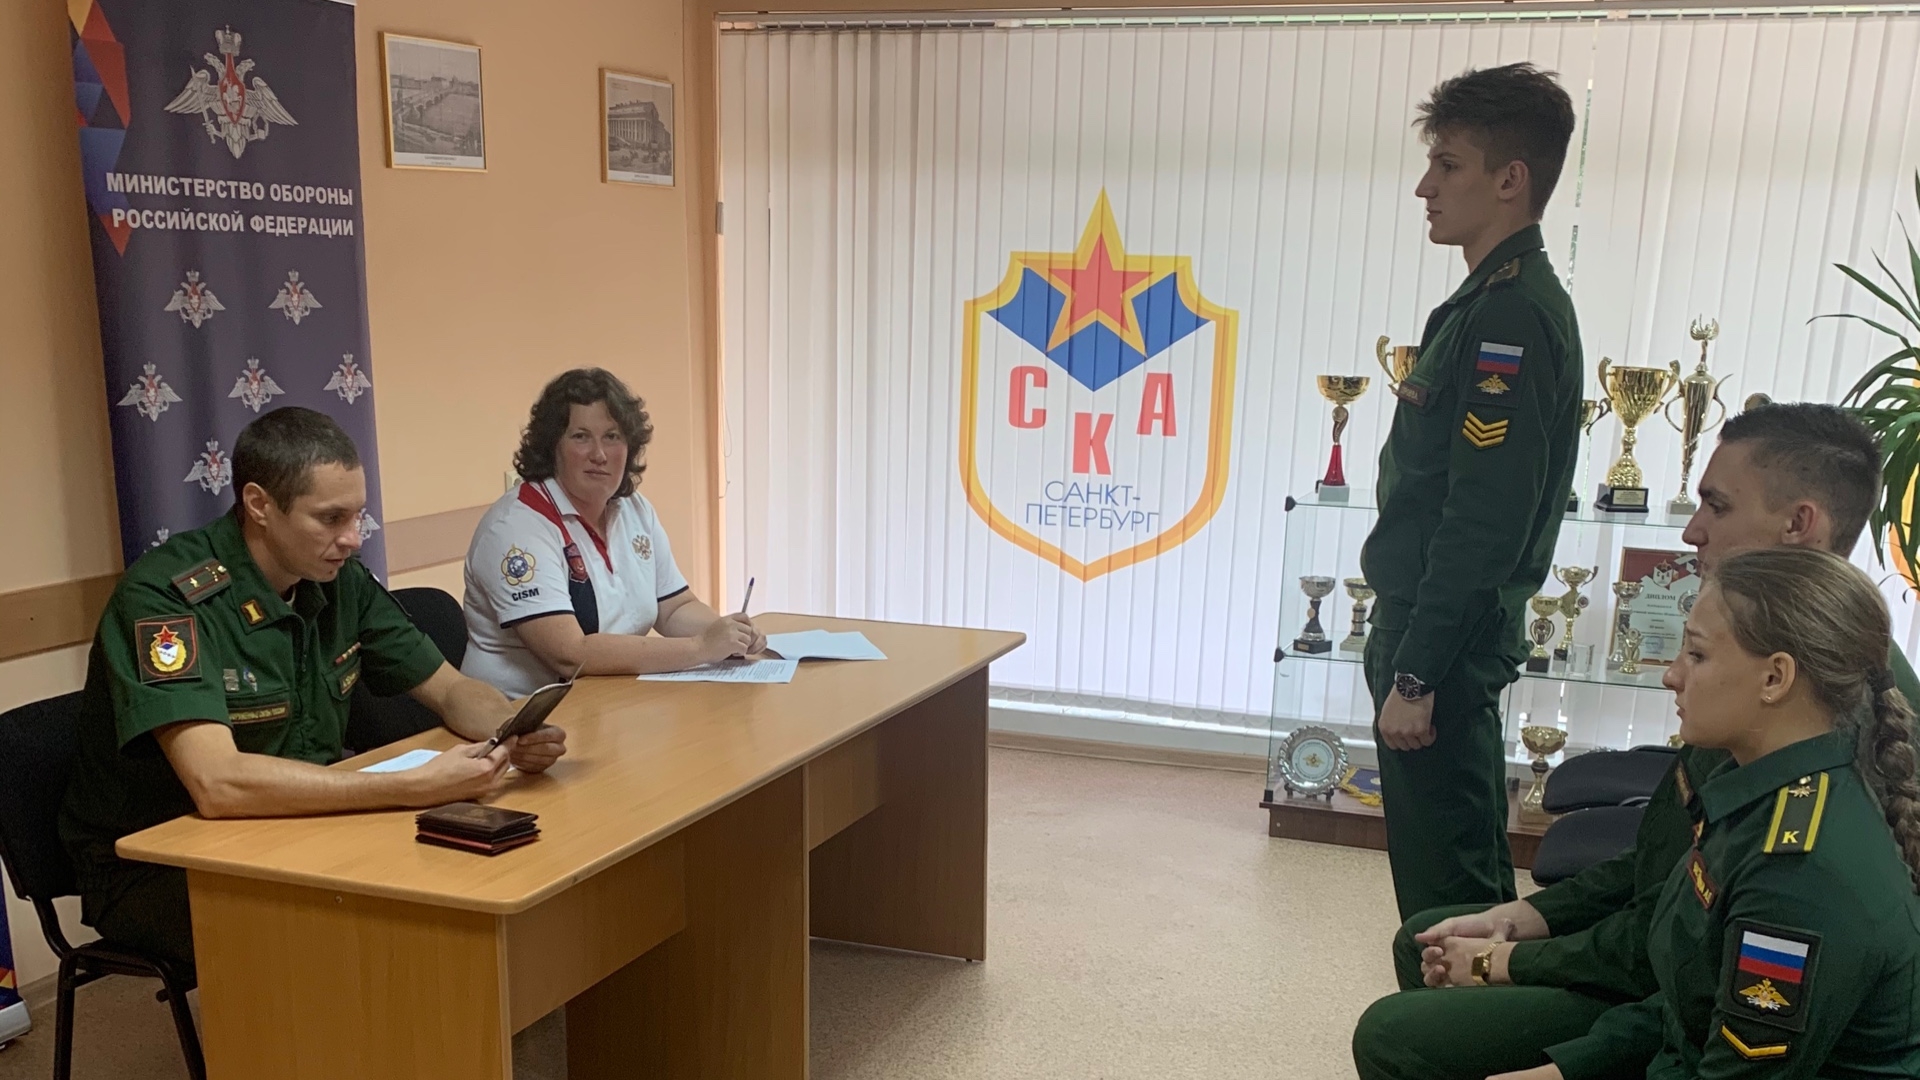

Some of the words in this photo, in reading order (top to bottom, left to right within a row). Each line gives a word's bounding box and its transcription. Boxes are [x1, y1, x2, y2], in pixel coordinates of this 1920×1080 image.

[106, 172, 265, 201] МИНИСТЕРСТВО
[269, 183, 354, 206] ОБОРОНЫ
[111, 208, 245, 232] РОССИЙСКОЙ
[249, 213, 354, 238] ФЕДЕРАЦИИ
[1044, 480, 1142, 507] САНКТ-
[1025, 503, 1160, 533] ПЕТЕРБУРГ
[511, 587, 540, 602] CISM
[1781, 830, 1800, 844] К
